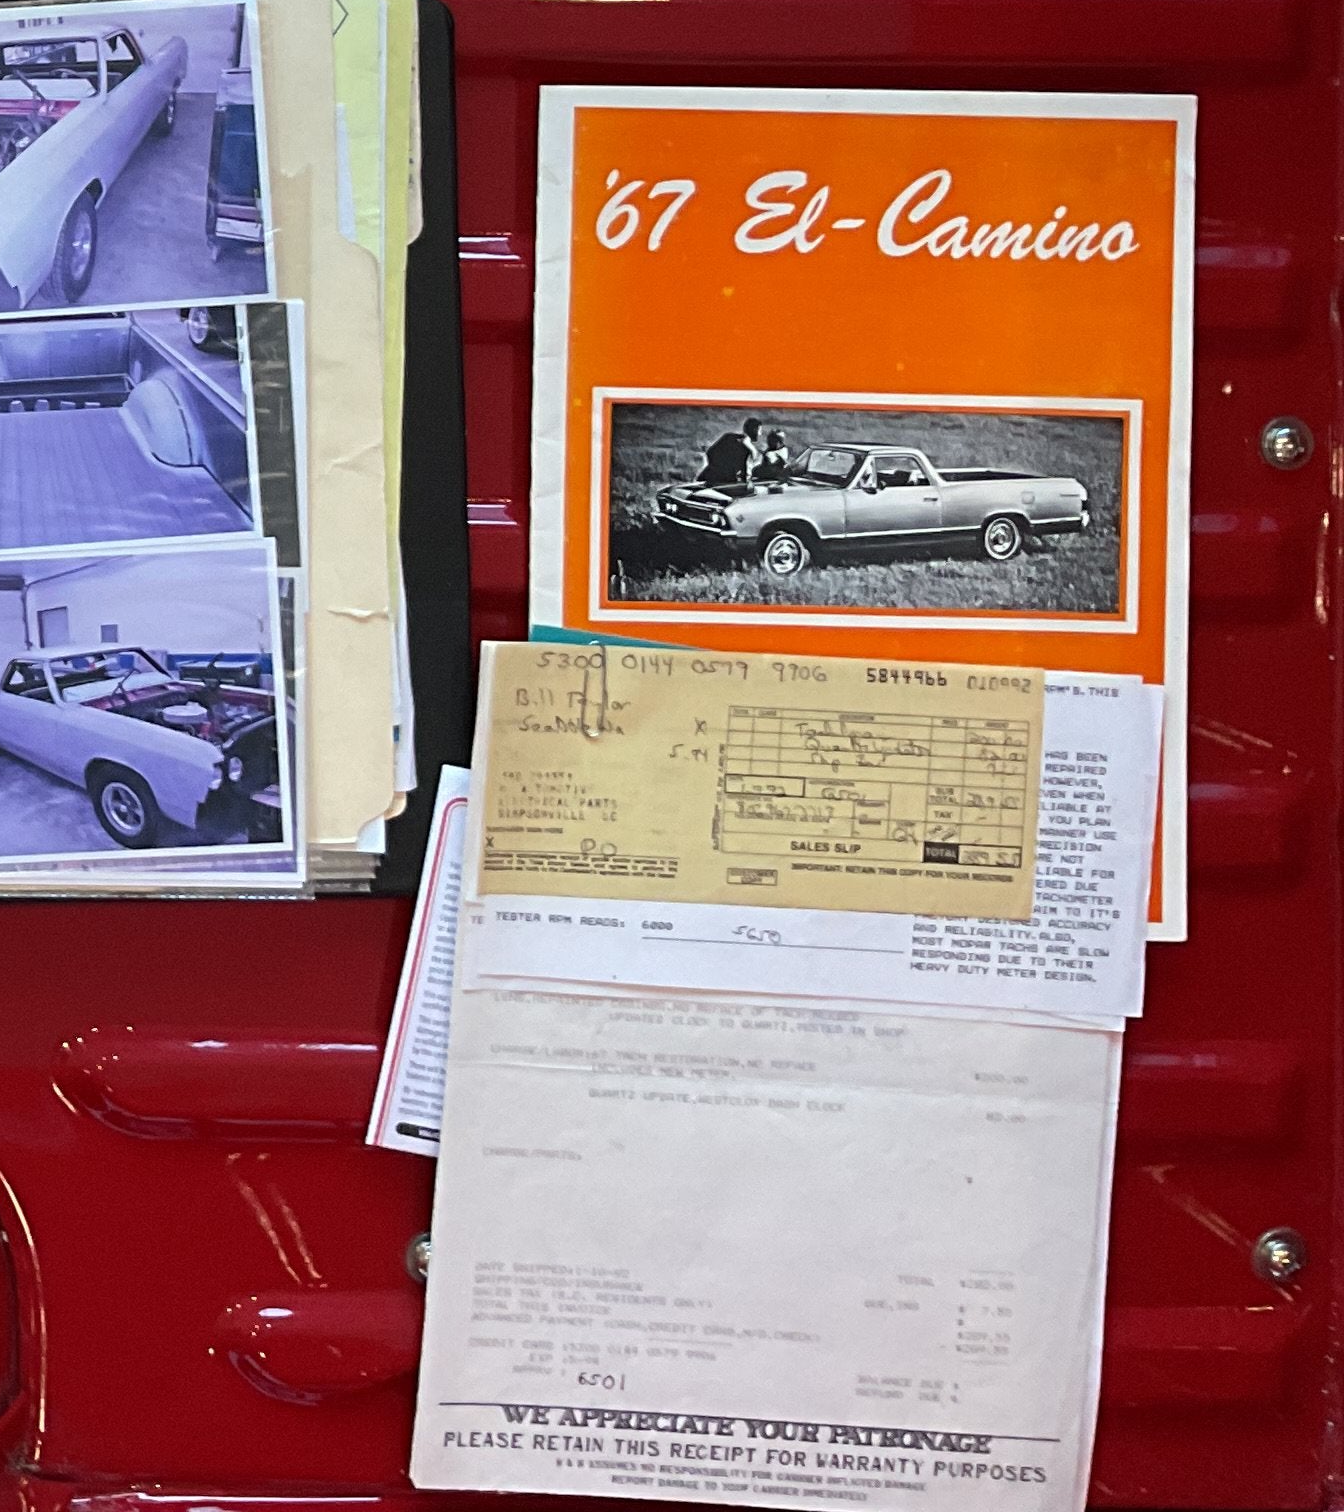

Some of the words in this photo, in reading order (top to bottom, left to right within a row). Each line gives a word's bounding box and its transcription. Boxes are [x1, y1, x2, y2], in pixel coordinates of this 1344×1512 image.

[594, 169, 696, 252] '67
[733, 168, 1140, 262] El-Camino
[866, 668, 948, 688] 5844966
[1045, 765, 1107, 776] REPAIRED
[1073, 792, 1105, 801] WHEN
[790, 841, 832, 853] SALES
[835, 843, 861, 854] SLIP
[925, 847, 958, 859] TOTAL
[1061, 854, 1084, 865] NOT
[1036, 892, 1114, 906] TACHOMETER
[496, 911, 541, 923] TESTER
[548, 914, 572, 924] RPM
[580, 915, 626, 928] READS:
[642, 920, 673, 931] 6000
[913, 922, 938, 932] AND
[1049, 919, 1112, 931] ACCURACY
[951, 939, 992, 949] MOPAR
[1000, 941, 1039, 953] TACHS
[912, 949, 992, 963] RESPONDING
[1055, 958, 1094, 969] THEIR
[910, 962, 950, 973] HEAVY
[997, 968, 1037, 979] METER
[577, 1372, 625, 1390] 6501
[501, 1405, 549, 1424] WE
[558, 1407, 734, 1437] APPRECIATE
[746, 1419, 819, 1443] YOUR
[828, 1427, 992, 1454] PATRONAGE
[443, 1431, 524, 1450] PLEASE
[532, 1434, 604, 1453] RETAIN
[614, 1438, 660, 1457] THIS
[669, 1443, 757, 1463] RECEIPT
[765, 1448, 806, 1467] FOR
[815, 1453, 923, 1475] WARRANTY
[933, 1460, 1047, 1484] PURPOSES
